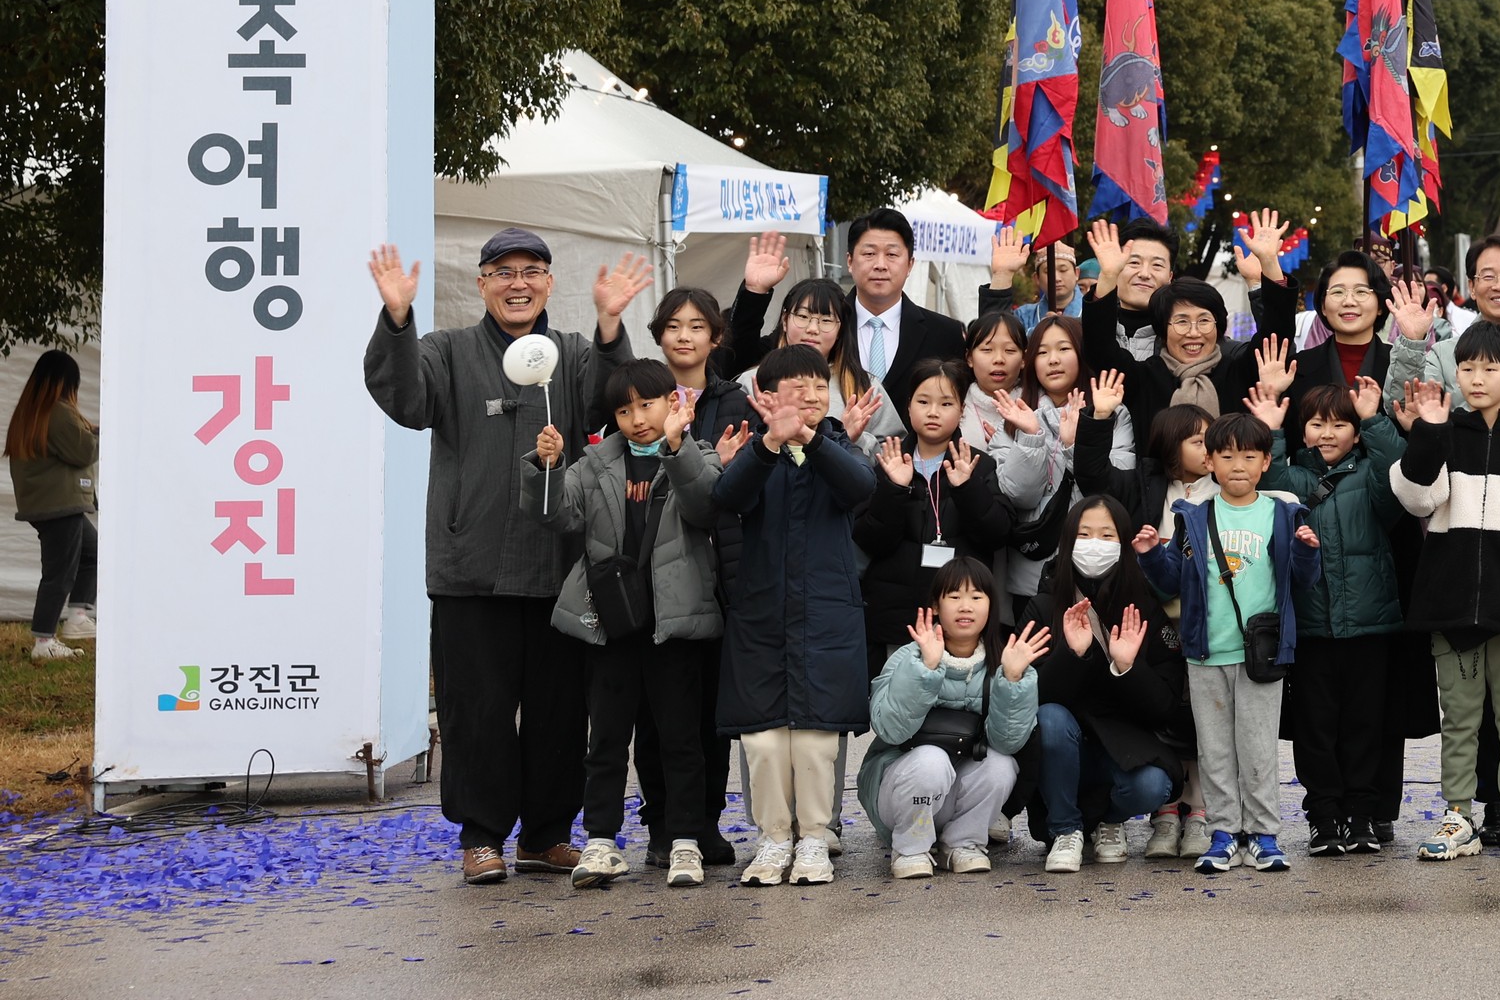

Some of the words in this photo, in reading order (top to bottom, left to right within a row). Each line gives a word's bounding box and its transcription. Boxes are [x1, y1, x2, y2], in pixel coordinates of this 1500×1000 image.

[192, 356, 295, 596] 강진
[209, 664, 320, 694] 강진군
[209, 696, 320, 711] GANGJINCITY
